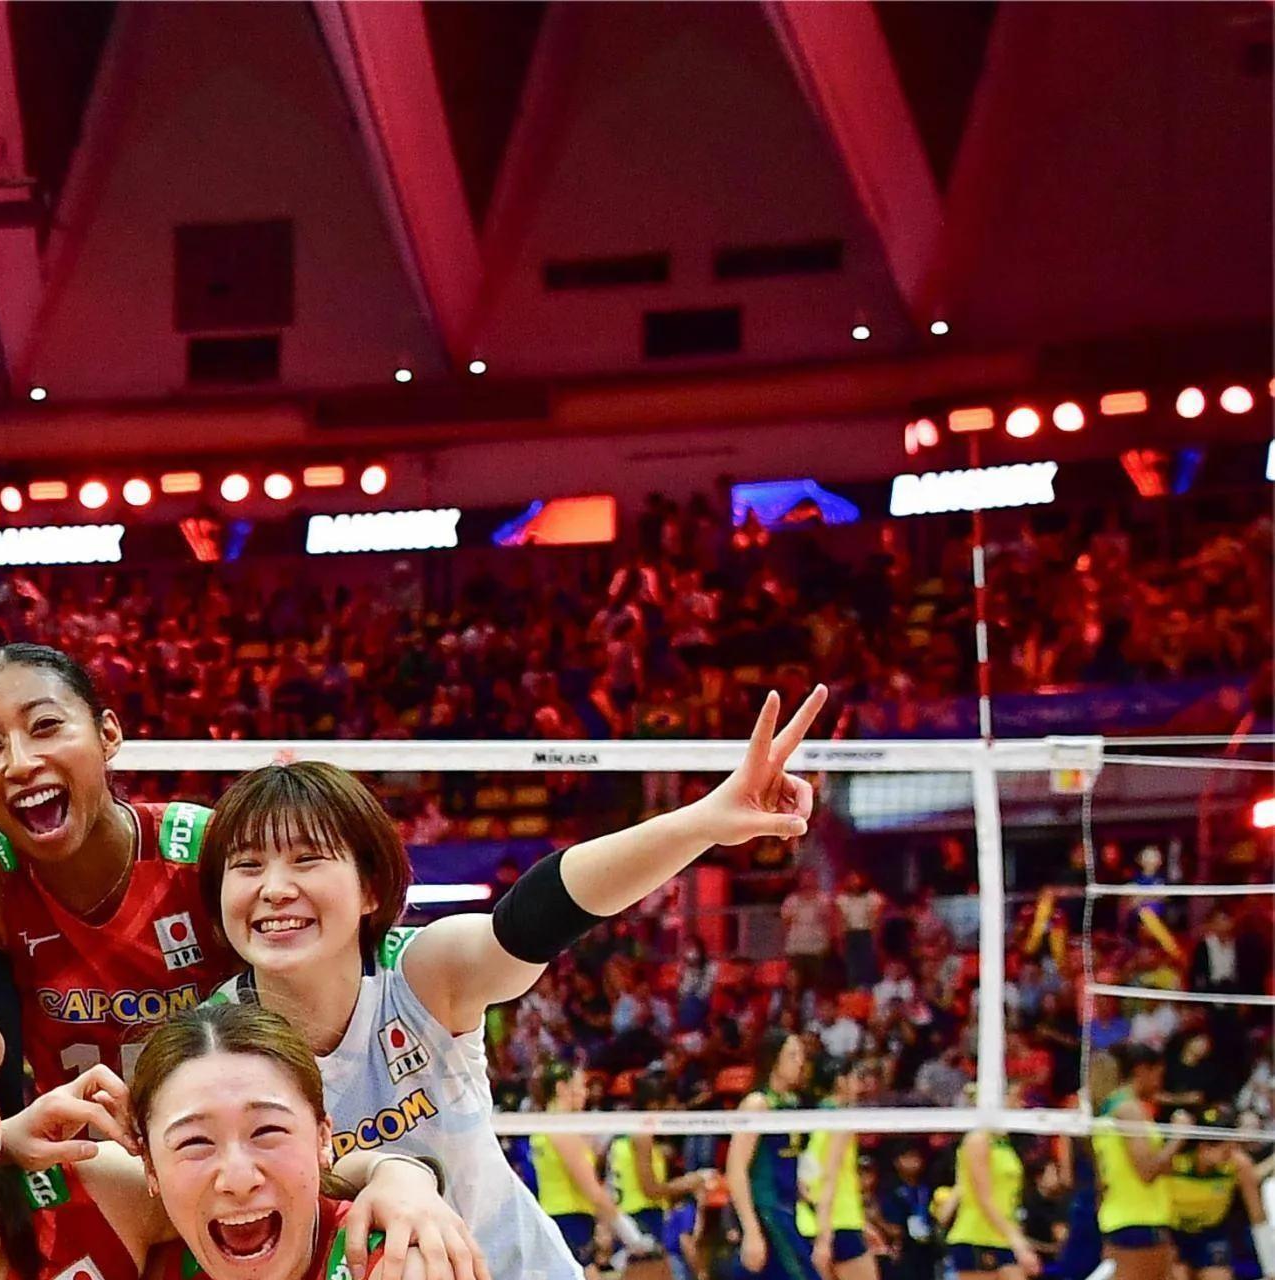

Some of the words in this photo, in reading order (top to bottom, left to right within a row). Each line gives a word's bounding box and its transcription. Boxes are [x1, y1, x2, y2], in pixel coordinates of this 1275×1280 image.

[173, 948, 203, 967] JPN
[37, 983, 199, 1026] CAPCOM
[396, 1051, 425, 1076] JPN
[331, 1088, 439, 1162] PCOM
